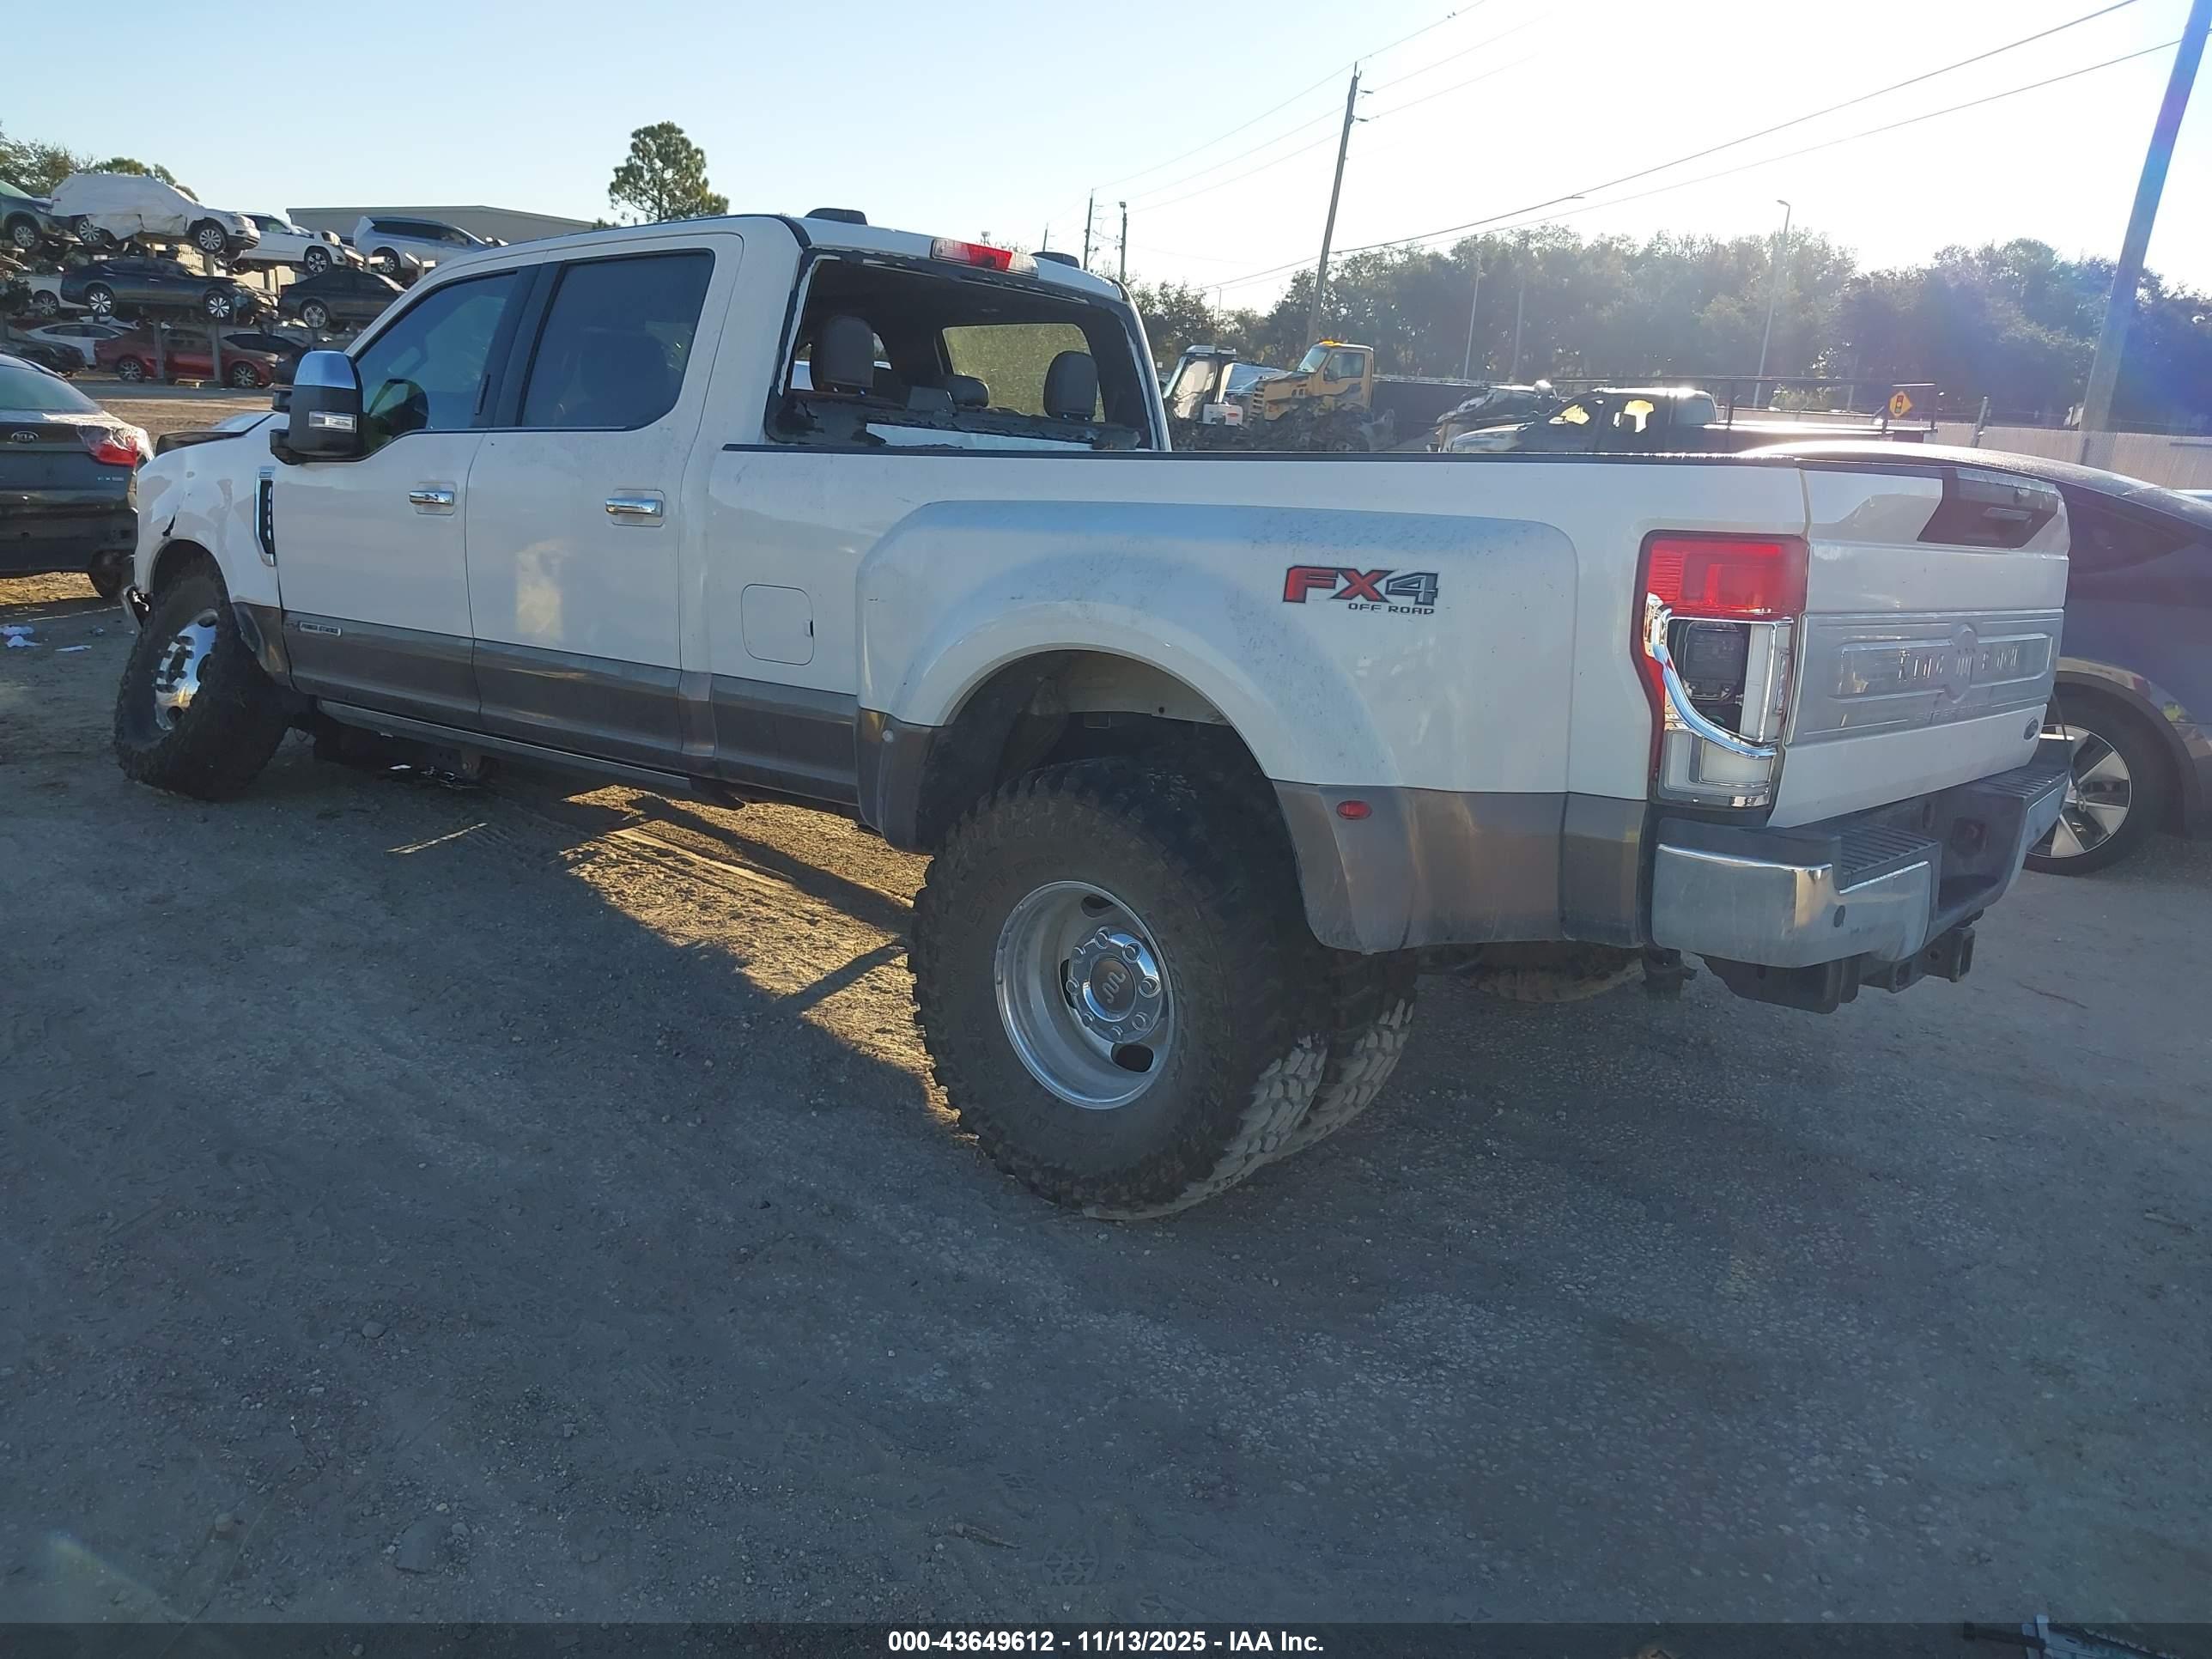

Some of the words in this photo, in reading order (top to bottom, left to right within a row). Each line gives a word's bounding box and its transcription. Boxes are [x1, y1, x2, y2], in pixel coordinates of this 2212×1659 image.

[1283, 566, 1438, 606] FX4
[1348, 603, 1382, 612] OFF
[1388, 605, 1435, 615] ROAD
